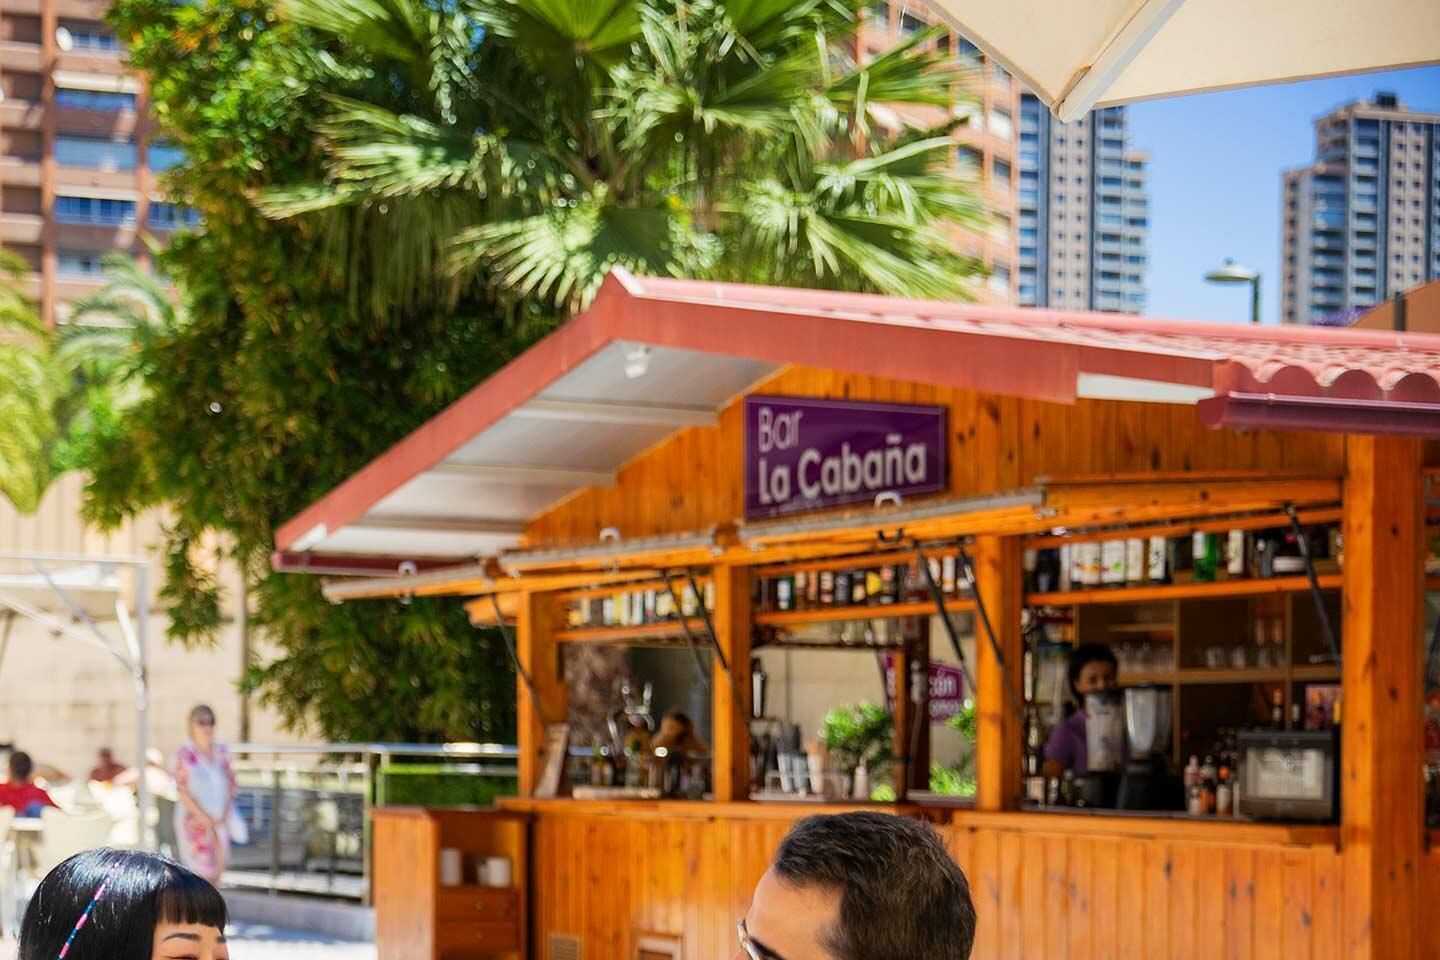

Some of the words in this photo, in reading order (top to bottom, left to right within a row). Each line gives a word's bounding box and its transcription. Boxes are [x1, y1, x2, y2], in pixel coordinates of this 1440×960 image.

[758, 407, 803, 452] Bar
[759, 459, 792, 505] La
[798, 433, 928, 499] Cabaña
